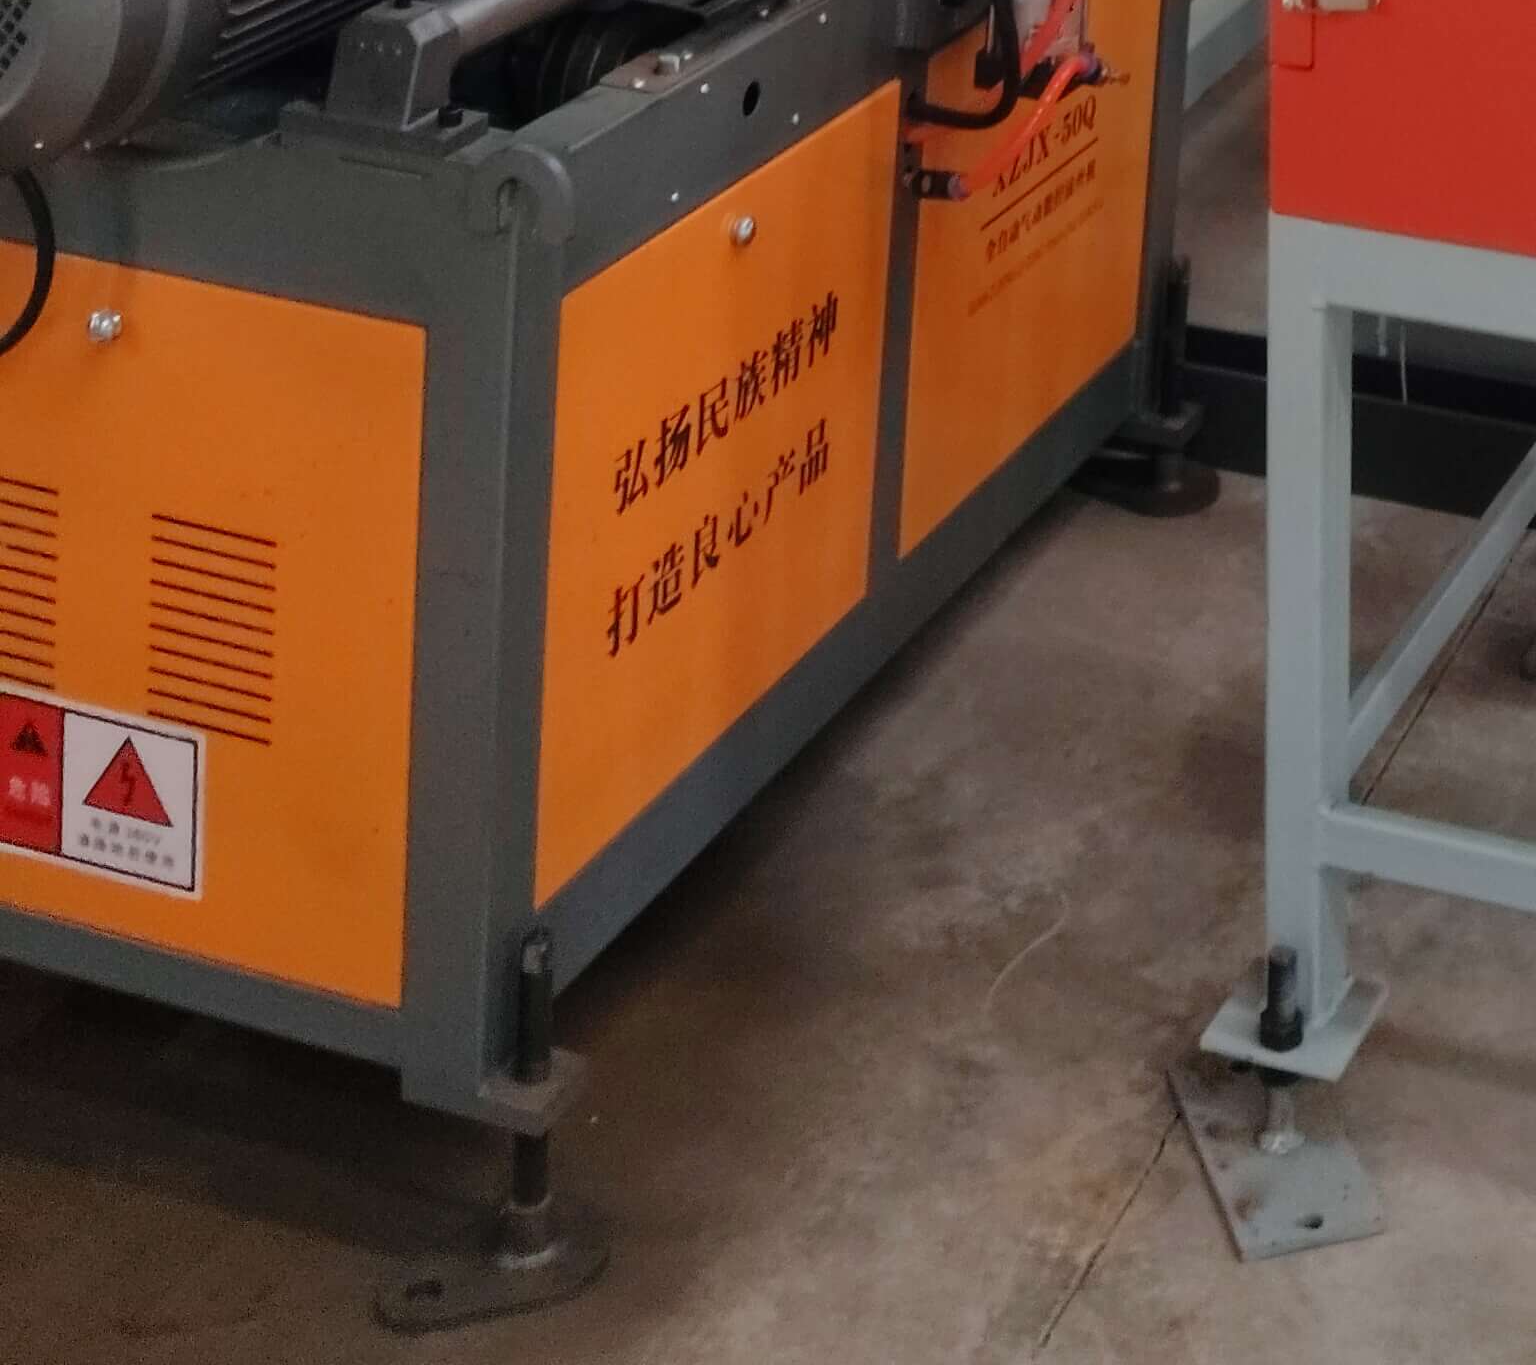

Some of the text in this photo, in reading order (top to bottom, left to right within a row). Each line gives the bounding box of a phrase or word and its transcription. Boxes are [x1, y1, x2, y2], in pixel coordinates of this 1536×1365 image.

[613, 290, 839, 516] 弘扬民族精神
[606, 418, 829, 658] 打造良心产品
